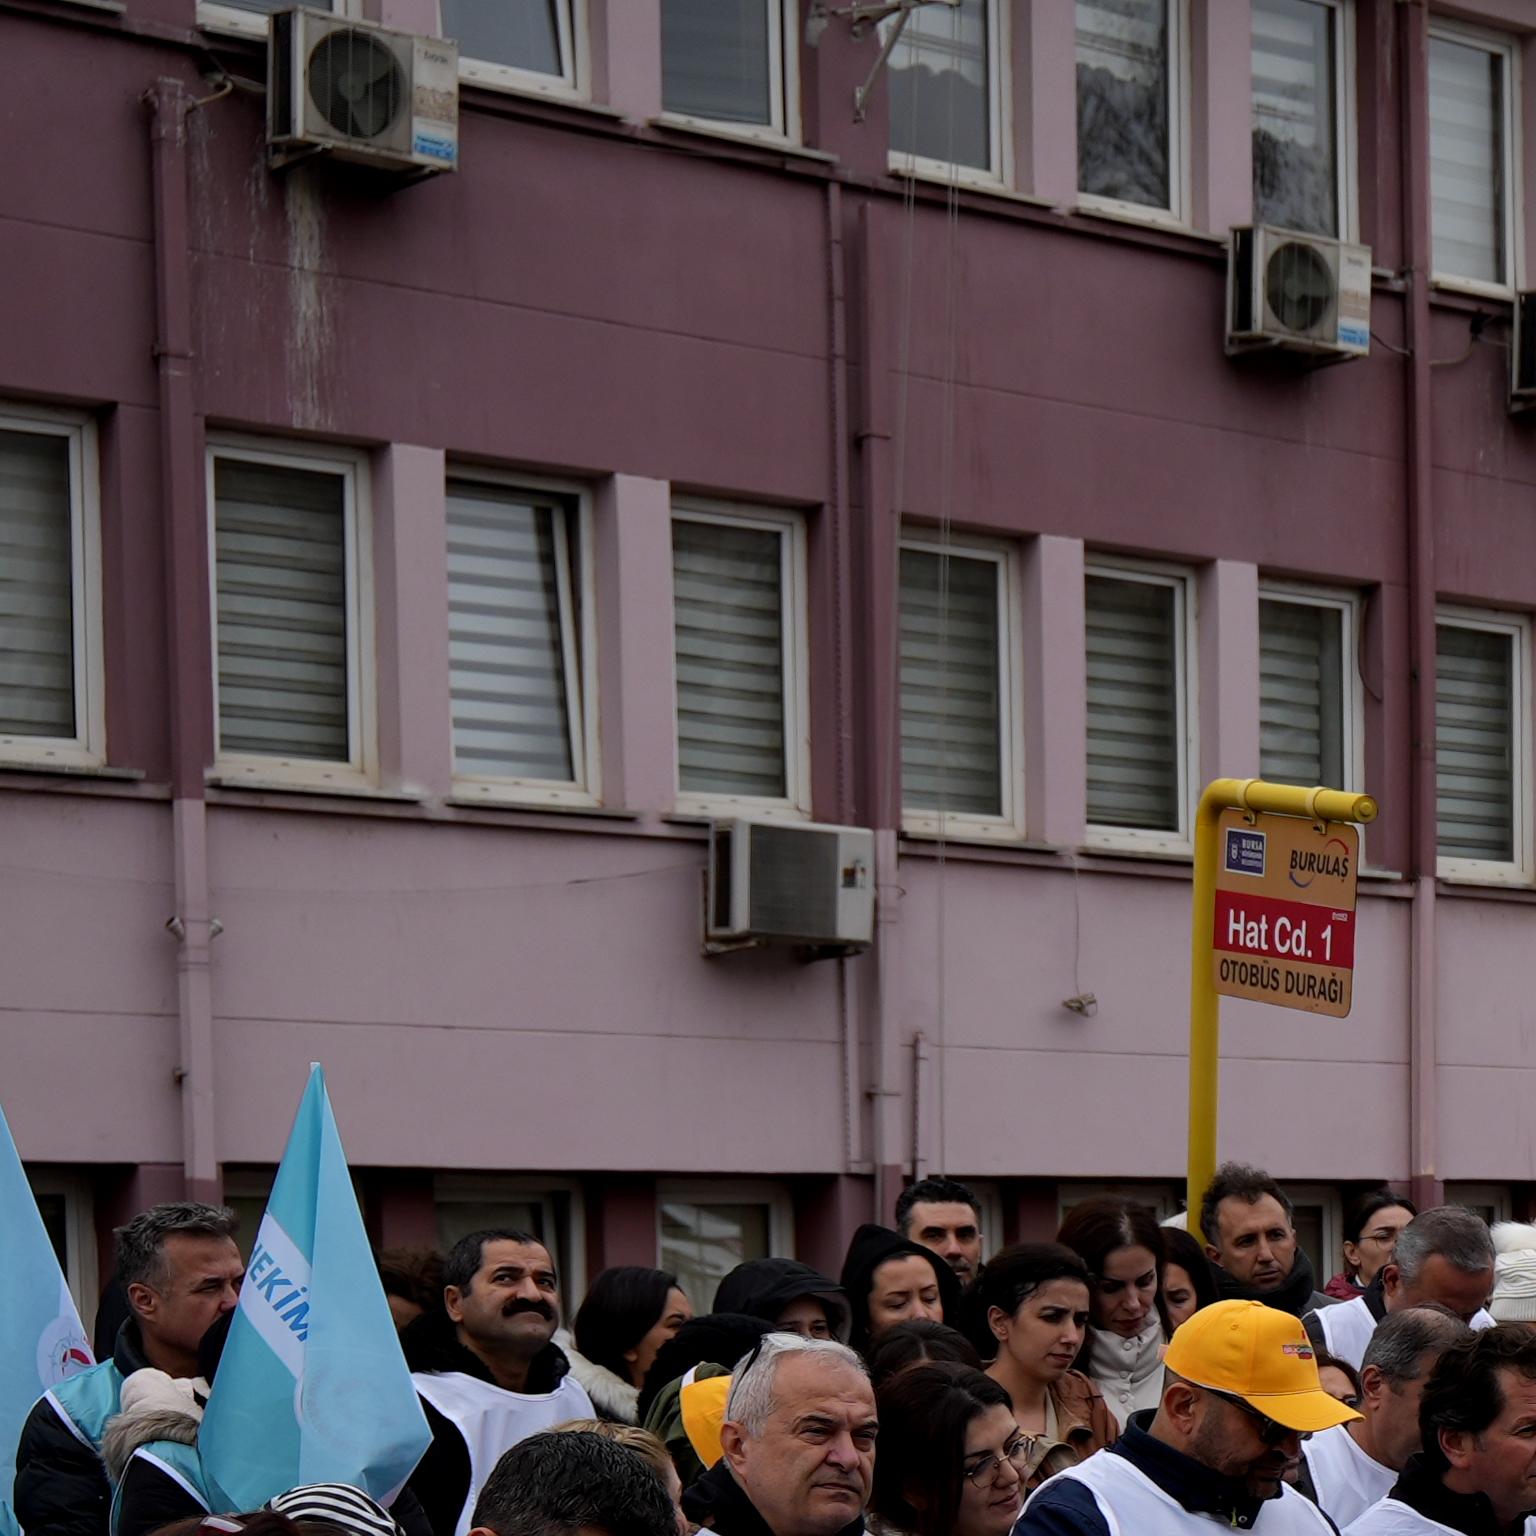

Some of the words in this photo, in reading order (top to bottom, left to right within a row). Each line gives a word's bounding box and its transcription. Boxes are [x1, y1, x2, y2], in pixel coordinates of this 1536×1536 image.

[1290, 850, 1349, 883] BURULAŞ
[1228, 908, 1269, 950] Hat
[1274, 916, 1313, 958] Cd.
[1321, 924, 1332, 961] 1
[1220, 958, 1280, 991] OTOBÜS
[1285, 972, 1344, 1004] DURAĞI
